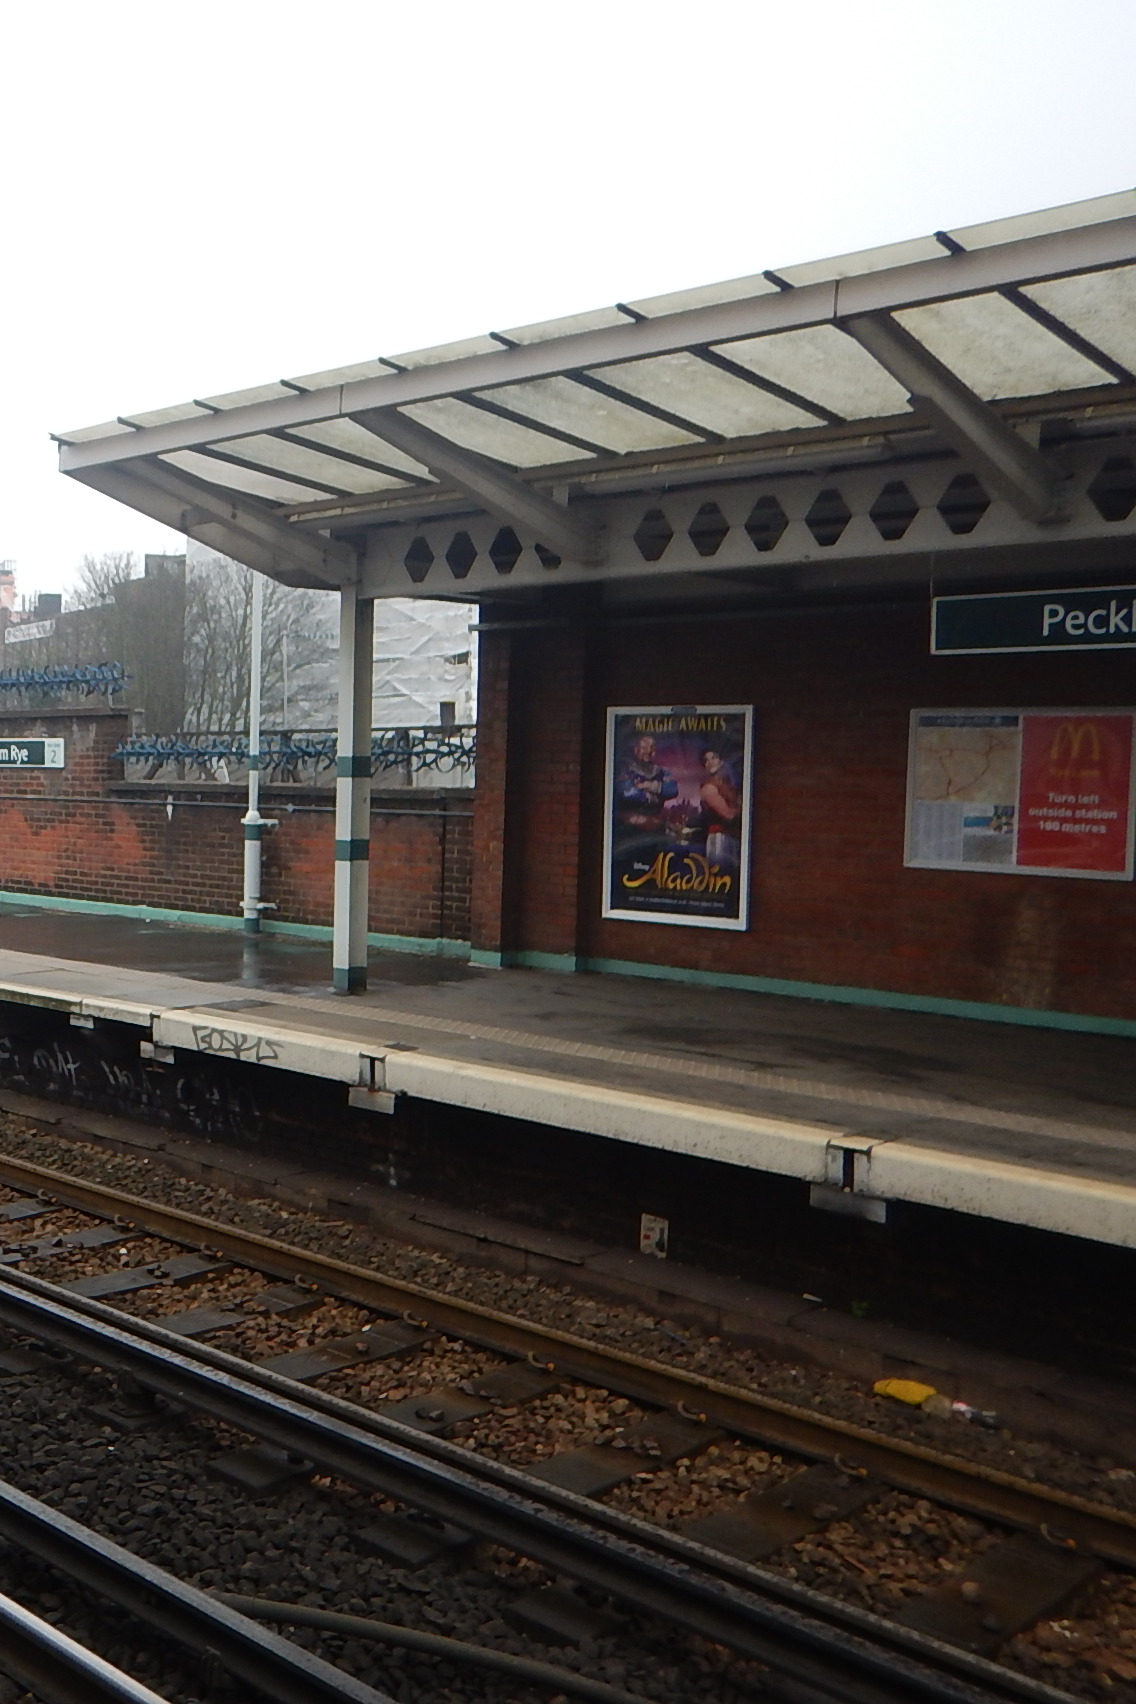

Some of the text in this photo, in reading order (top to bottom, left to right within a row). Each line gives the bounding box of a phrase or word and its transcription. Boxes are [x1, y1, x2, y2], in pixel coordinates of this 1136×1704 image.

[10, 744, 29, 765] Rye
[50, 749, 57, 764] 2
[1048, 792, 1076, 804] Turn
[1075, 809, 1118, 820] station
[622, 851, 731, 893] Aladdin
